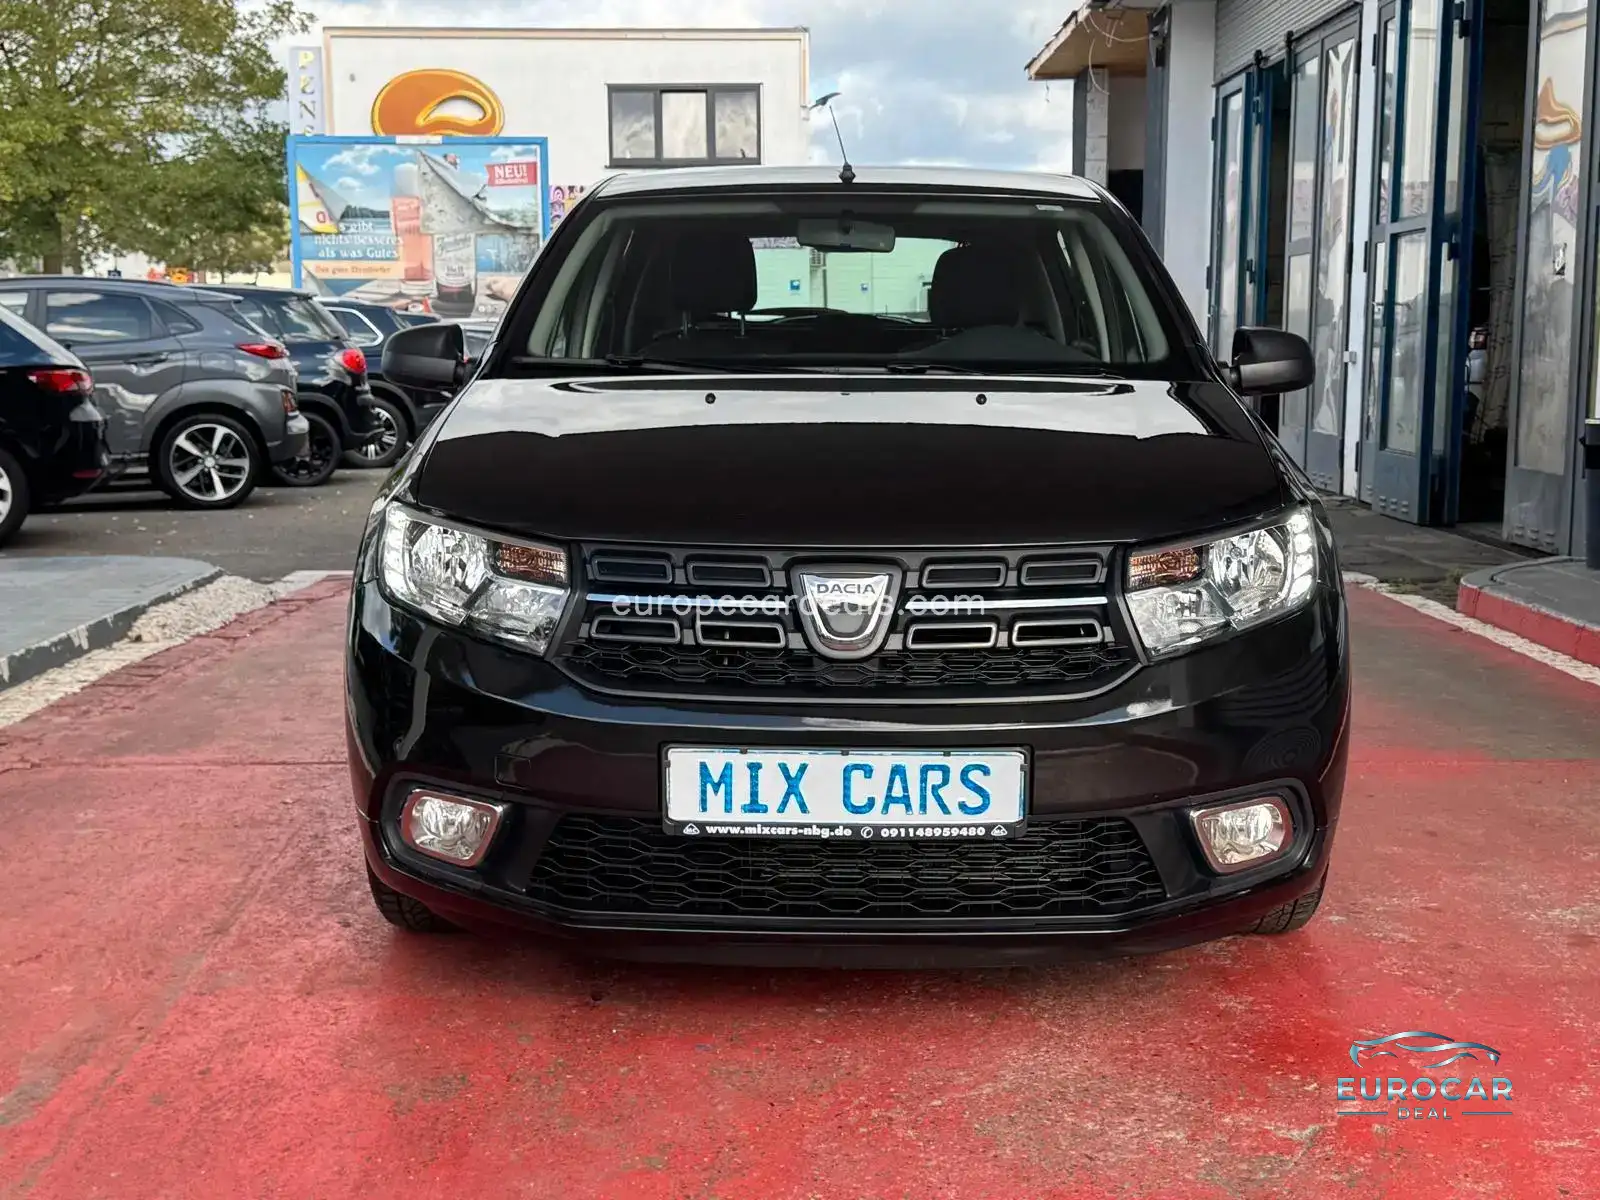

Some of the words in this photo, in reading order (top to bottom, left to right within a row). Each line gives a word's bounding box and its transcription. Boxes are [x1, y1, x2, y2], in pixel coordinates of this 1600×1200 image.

[494, 164, 528, 179] NEU!
[318, 247, 336, 258] als
[340, 248, 363, 258] was
[366, 247, 399, 259] Gutes
[816, 583, 875, 594] DACIA
[699, 761, 810, 815] MIX
[842, 763, 991, 815] CARS
[706, 824, 852, 838] www.mixcars-nbg.de
[880, 826, 986, 837] 091148959480
